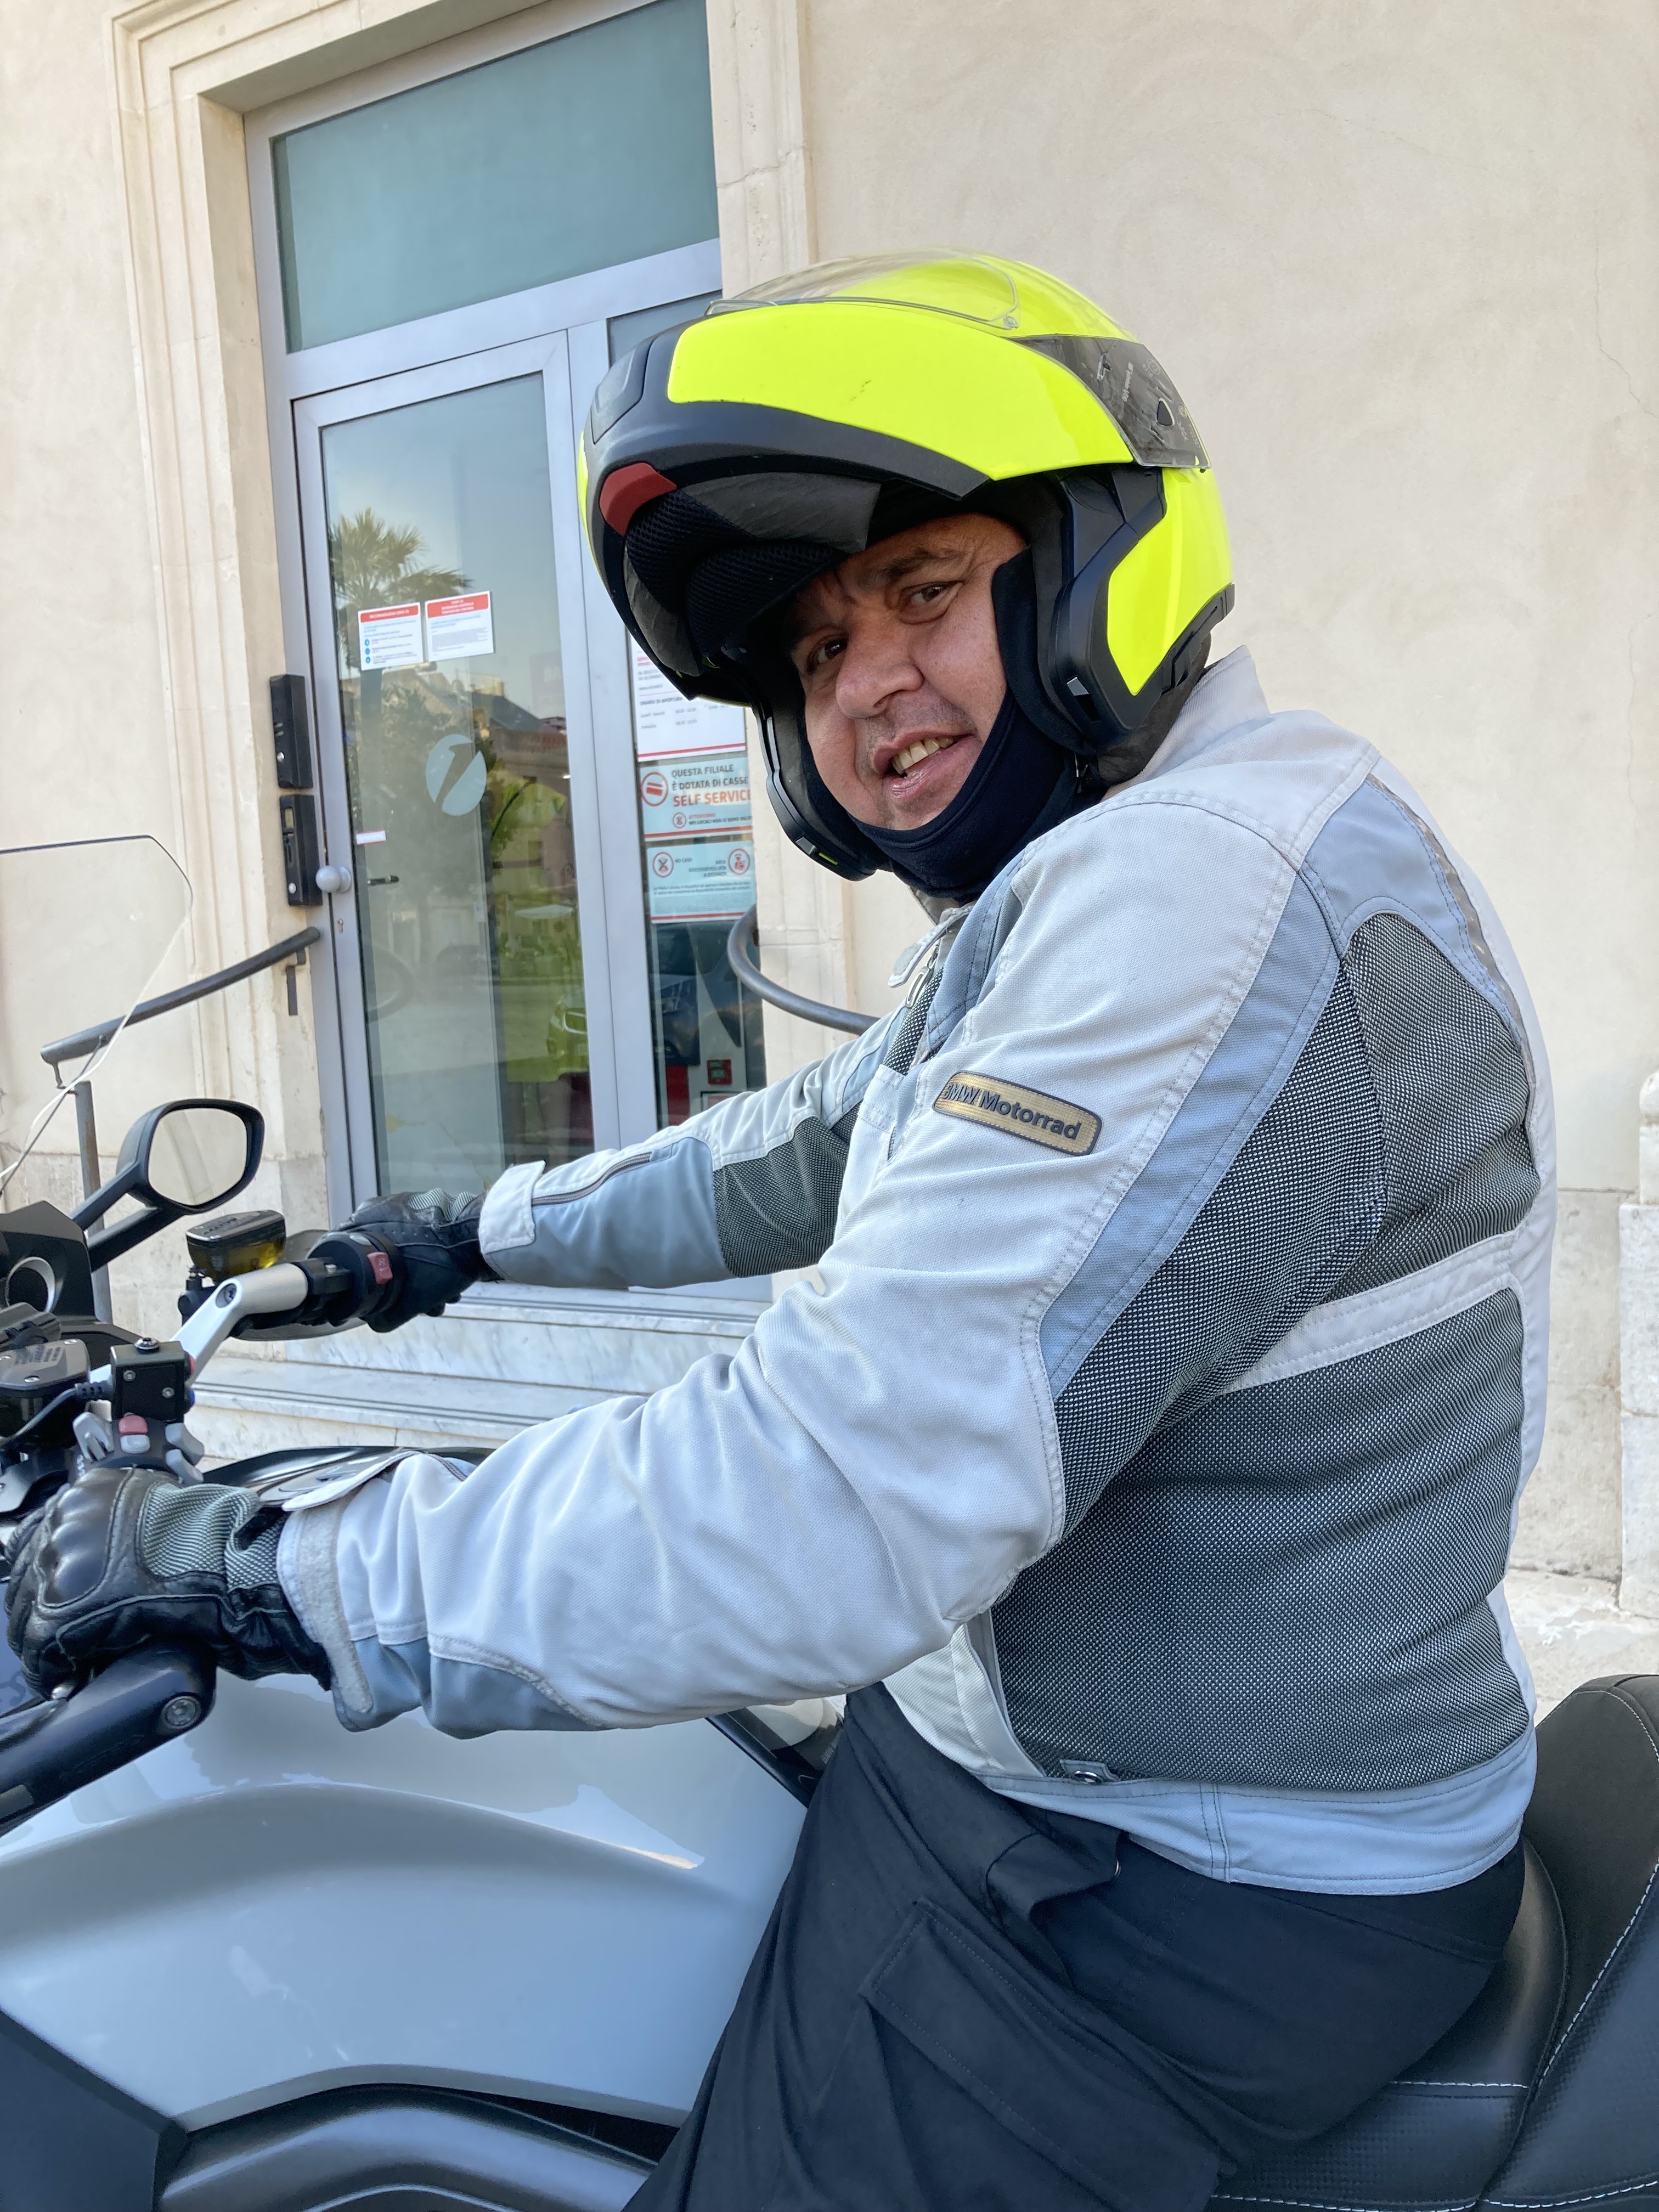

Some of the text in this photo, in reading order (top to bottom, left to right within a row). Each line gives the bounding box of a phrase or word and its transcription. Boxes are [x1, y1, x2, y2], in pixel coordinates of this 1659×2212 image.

[672, 764, 733, 779] QUESTA FILIALE
[672, 780, 677, 791] È
[679, 780, 710, 789] DOTATA
[723, 776, 748, 786] CASSE
[673, 793, 701, 807] SELF
[943, 1082, 1081, 1139] BMW Motorrad
